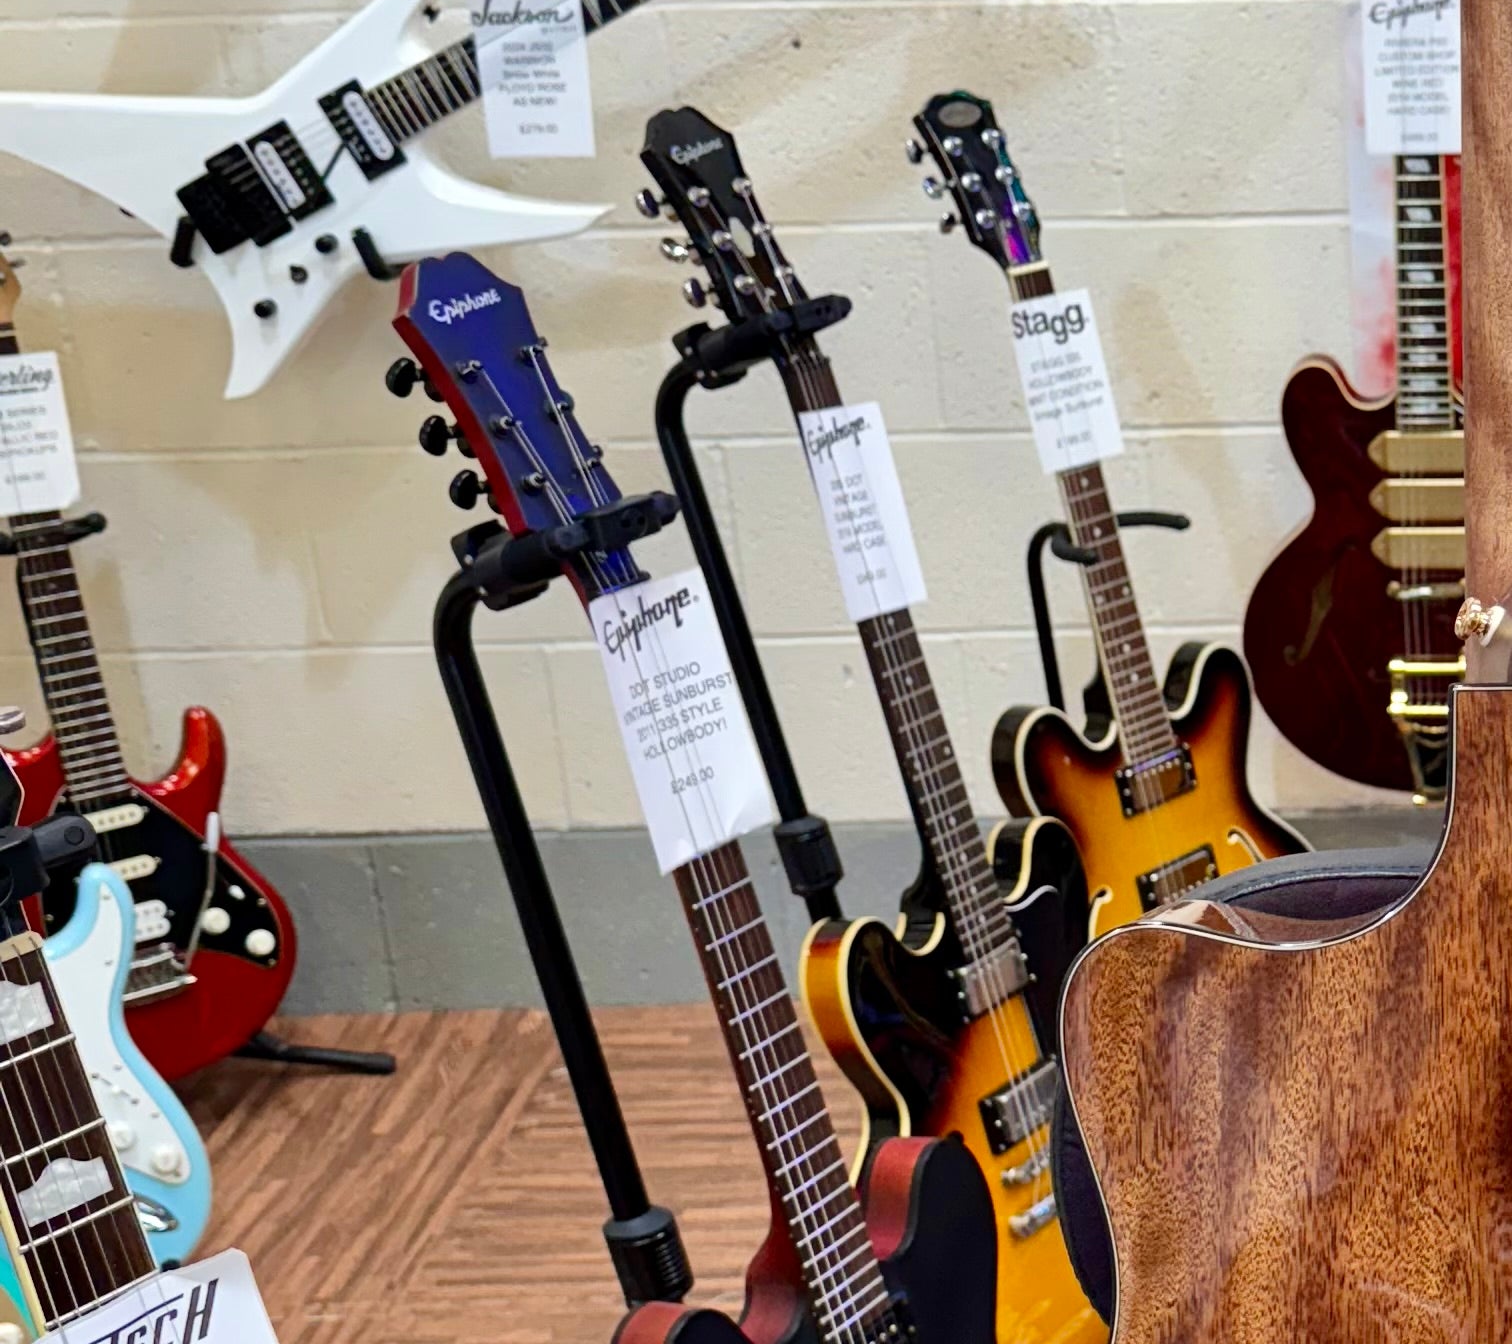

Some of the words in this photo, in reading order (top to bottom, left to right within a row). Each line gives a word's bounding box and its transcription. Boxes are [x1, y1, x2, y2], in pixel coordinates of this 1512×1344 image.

[428, 288, 501, 324] Epiphone
[0, 365, 53, 391] erling
[807, 416, 865, 463] Epiphone
[604, 587, 691, 662] Epiphone
[624, 697, 664, 726] VINTAGE
[664, 671, 734, 709] SUNBURST
[629, 677, 650, 699] DOT
[653, 661, 701, 690] STUDIO
[681, 697, 724, 725] STYLE
